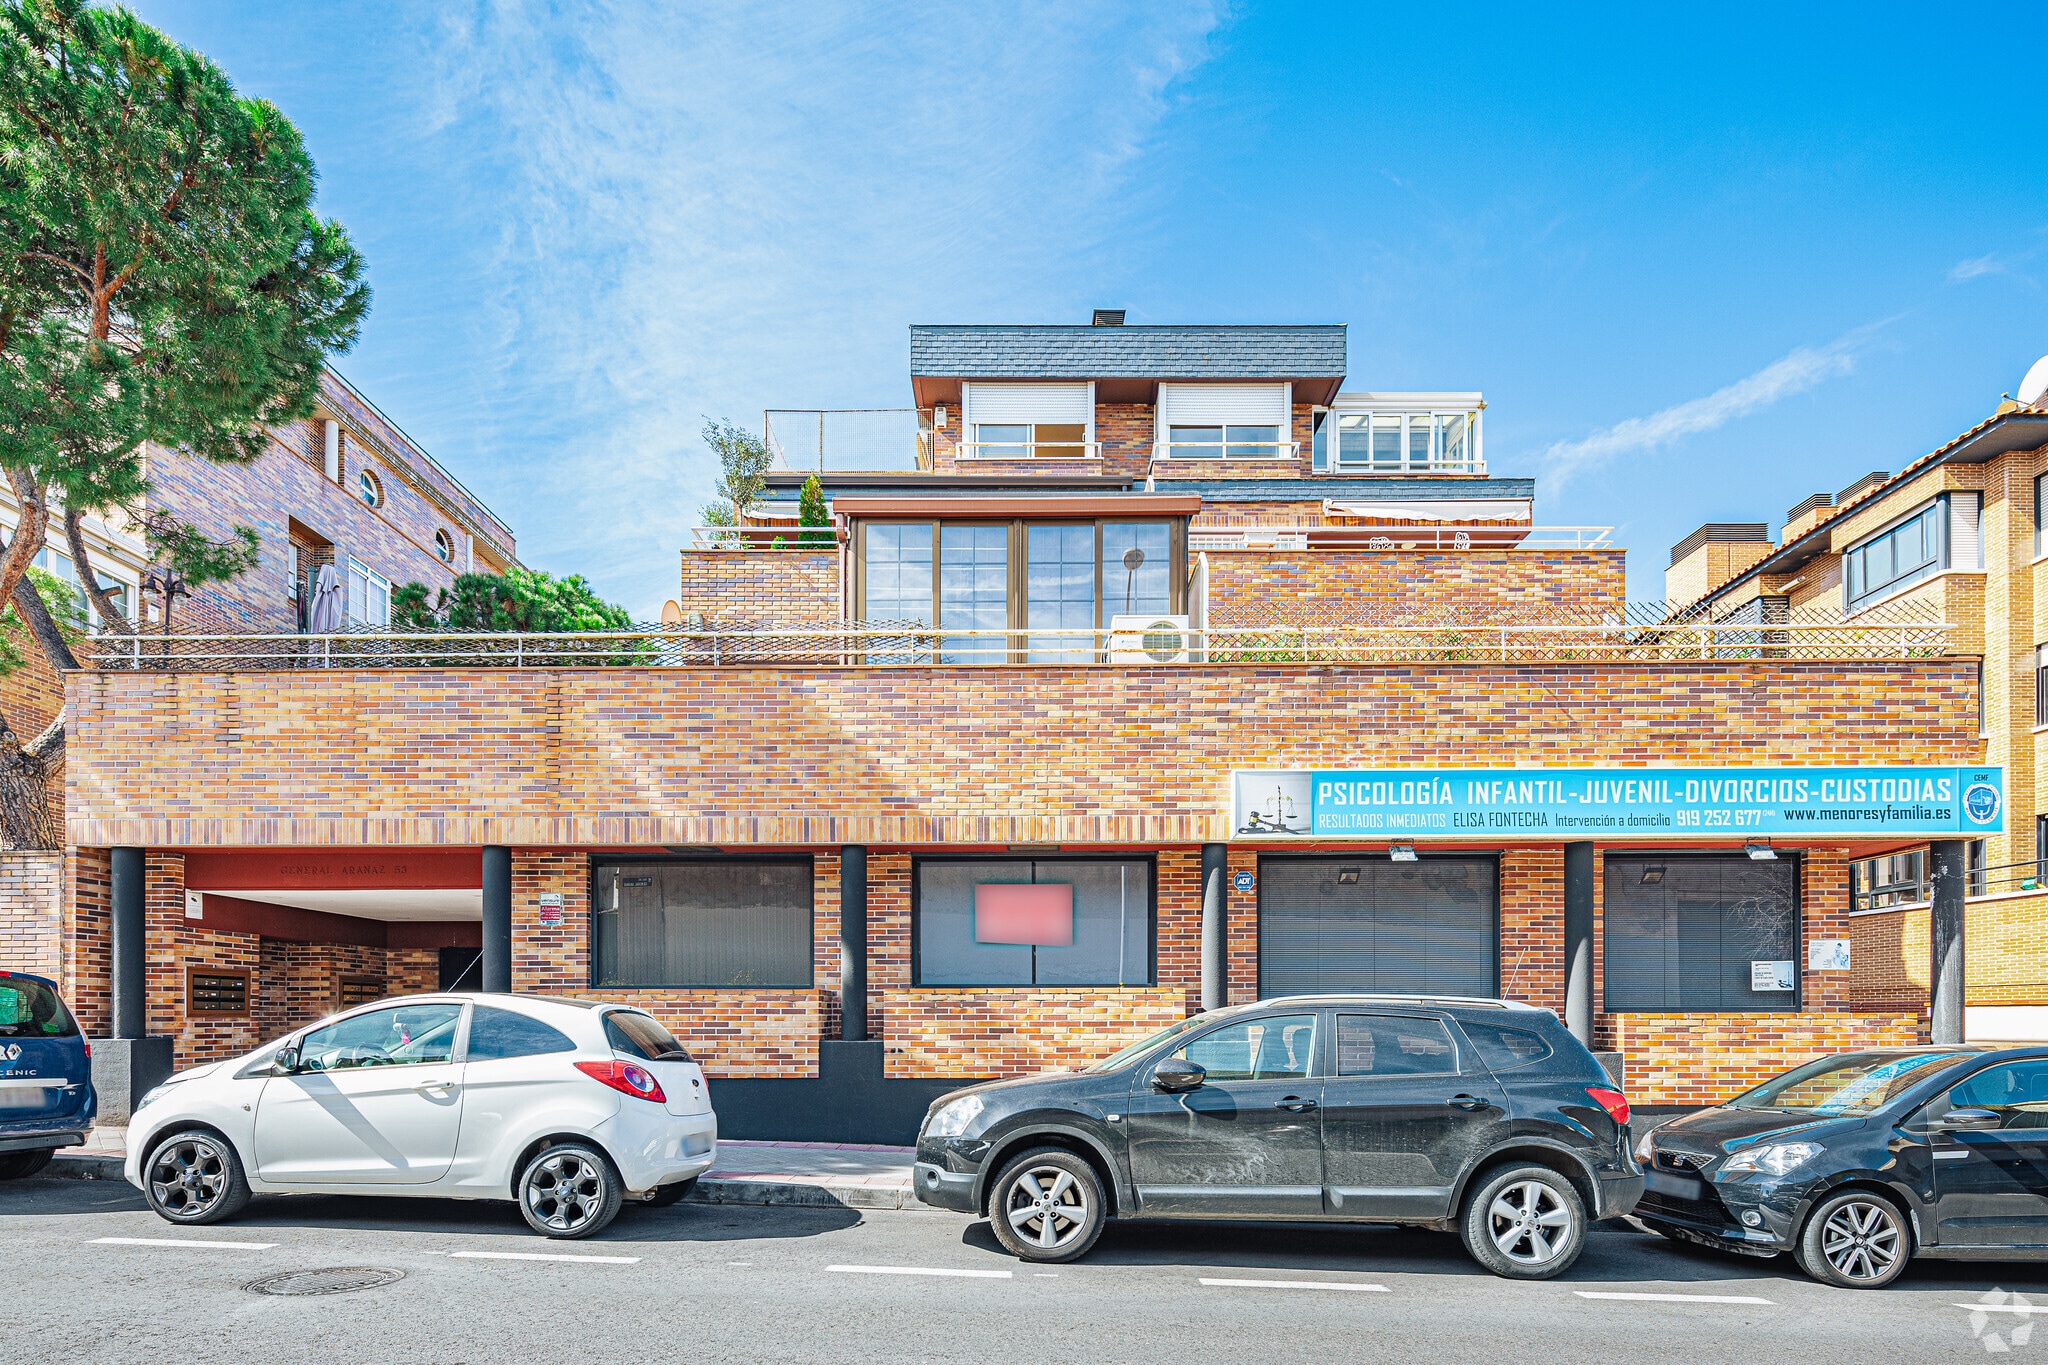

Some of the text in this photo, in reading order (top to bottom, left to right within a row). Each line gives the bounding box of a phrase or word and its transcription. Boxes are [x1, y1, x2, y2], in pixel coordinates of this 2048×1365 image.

[1974, 774, 1989, 782] CEMF
[1318, 776, 1453, 806] PSICOLOGÍA
[1467, 778, 1951, 805] INFANTIL-JUVENIL-DIVORCIOS-CUSTODIAS
[1319, 813, 1383, 828] RESULTADOS
[1386, 813, 1446, 828] INMEDIATOS
[1453, 812, 1485, 827] ELISA
[1489, 811, 1548, 827] FONTECHA
[1555, 812, 1615, 827] Intervención
[1619, 816, 1624, 827] a
[1627, 812, 1671, 827] domicilio
[1676, 810, 1700, 826] 919
[1704, 809, 1731, 826] 252
[1735, 809, 1762, 826] 677
[1784, 804, 1951, 823] www.menoresyfamilia.es
[280, 865, 407, 875] GENERAL ARANAZ 53
[1237, 877, 1251, 885] ADT
